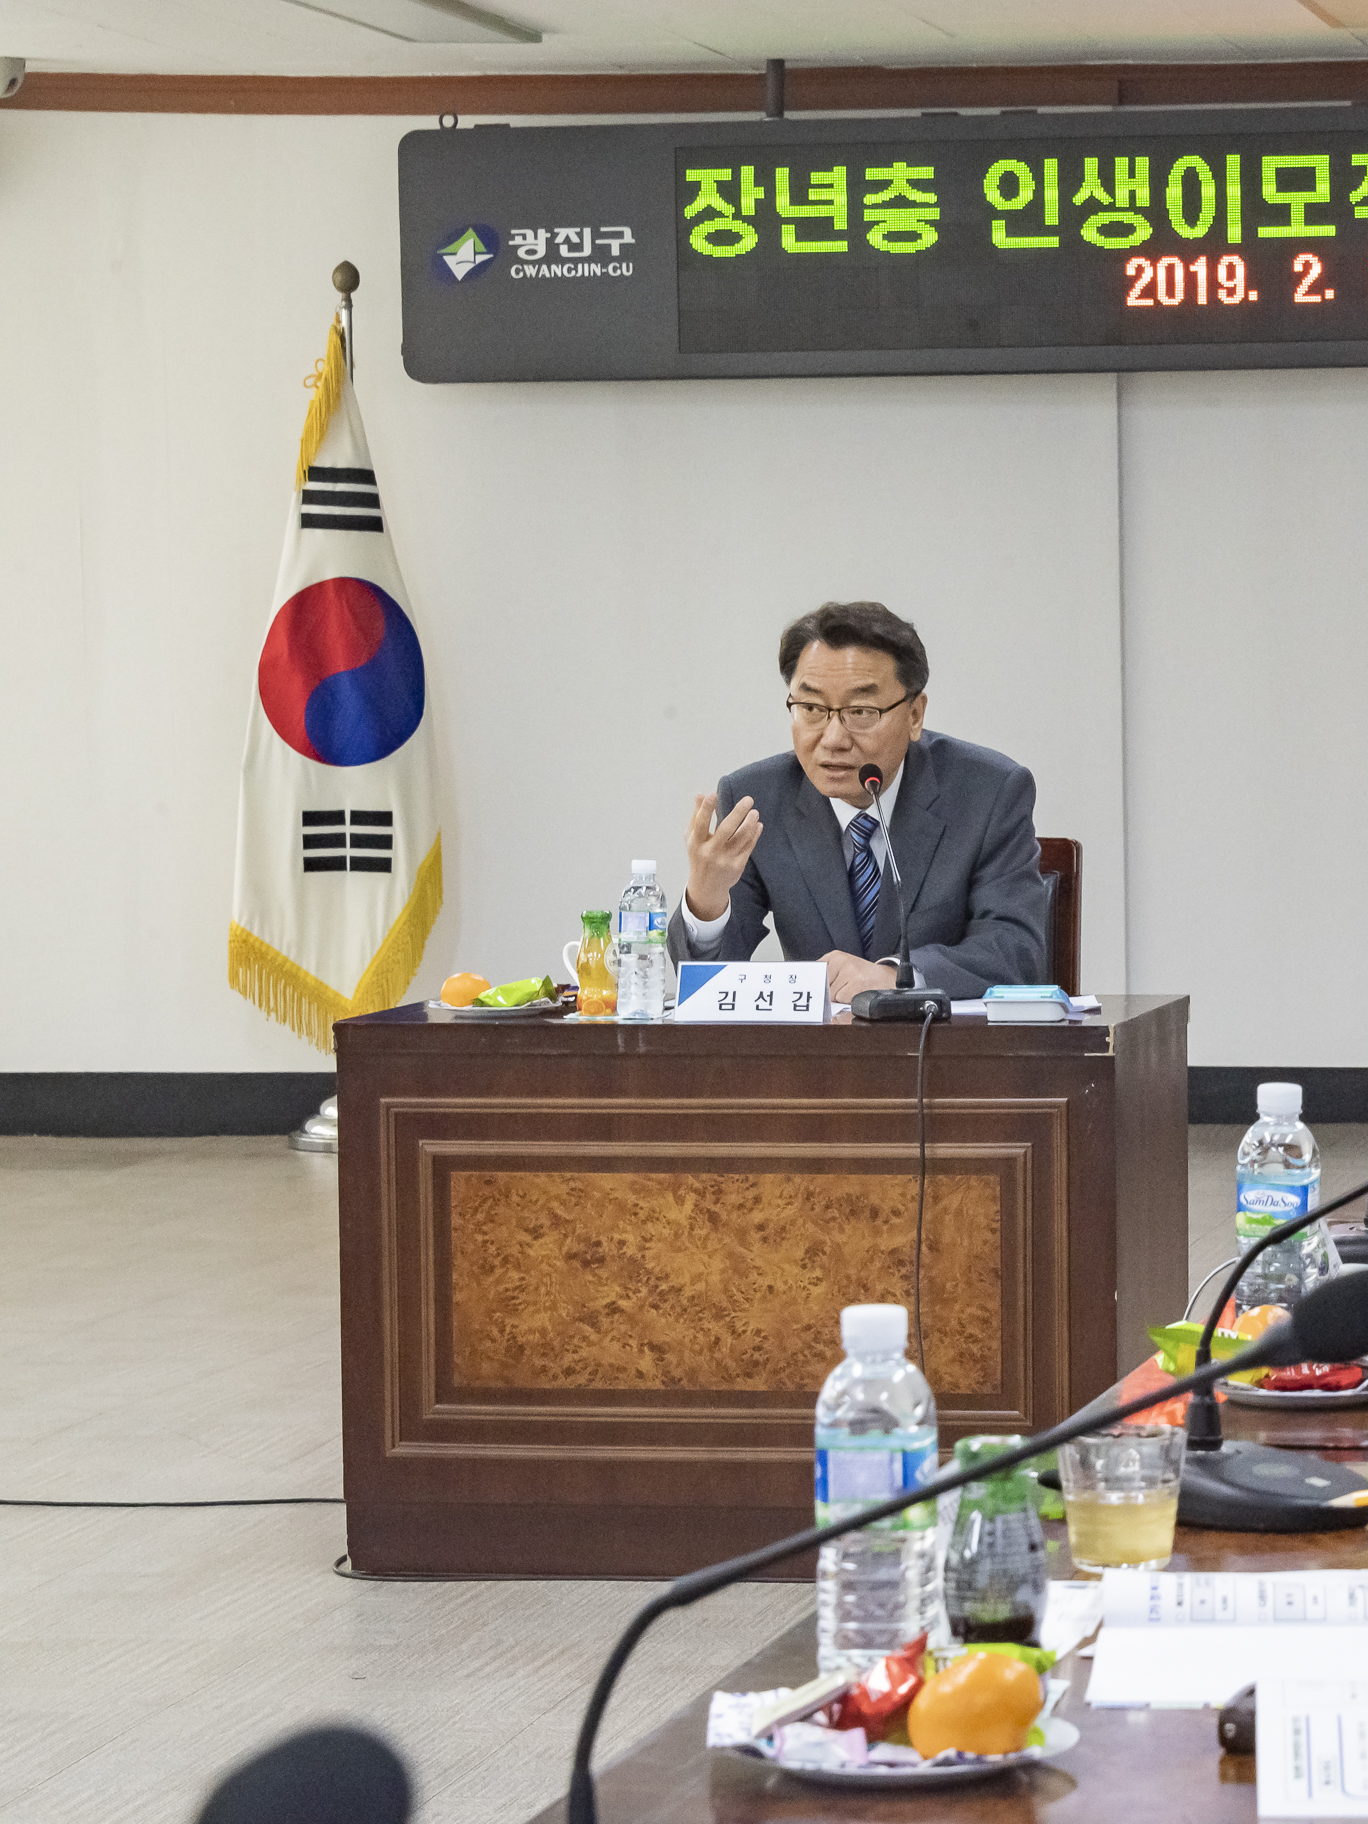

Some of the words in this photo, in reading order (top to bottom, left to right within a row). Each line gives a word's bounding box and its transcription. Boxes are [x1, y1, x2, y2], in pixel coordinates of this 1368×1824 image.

[684, 162, 940, 257] 장년층
[509, 227, 635, 260] 광진구
[511, 263, 632, 278] GWANGJIN-GU
[1126, 255, 1258, 306] 2019.
[1293, 253, 1334, 302] 2.
